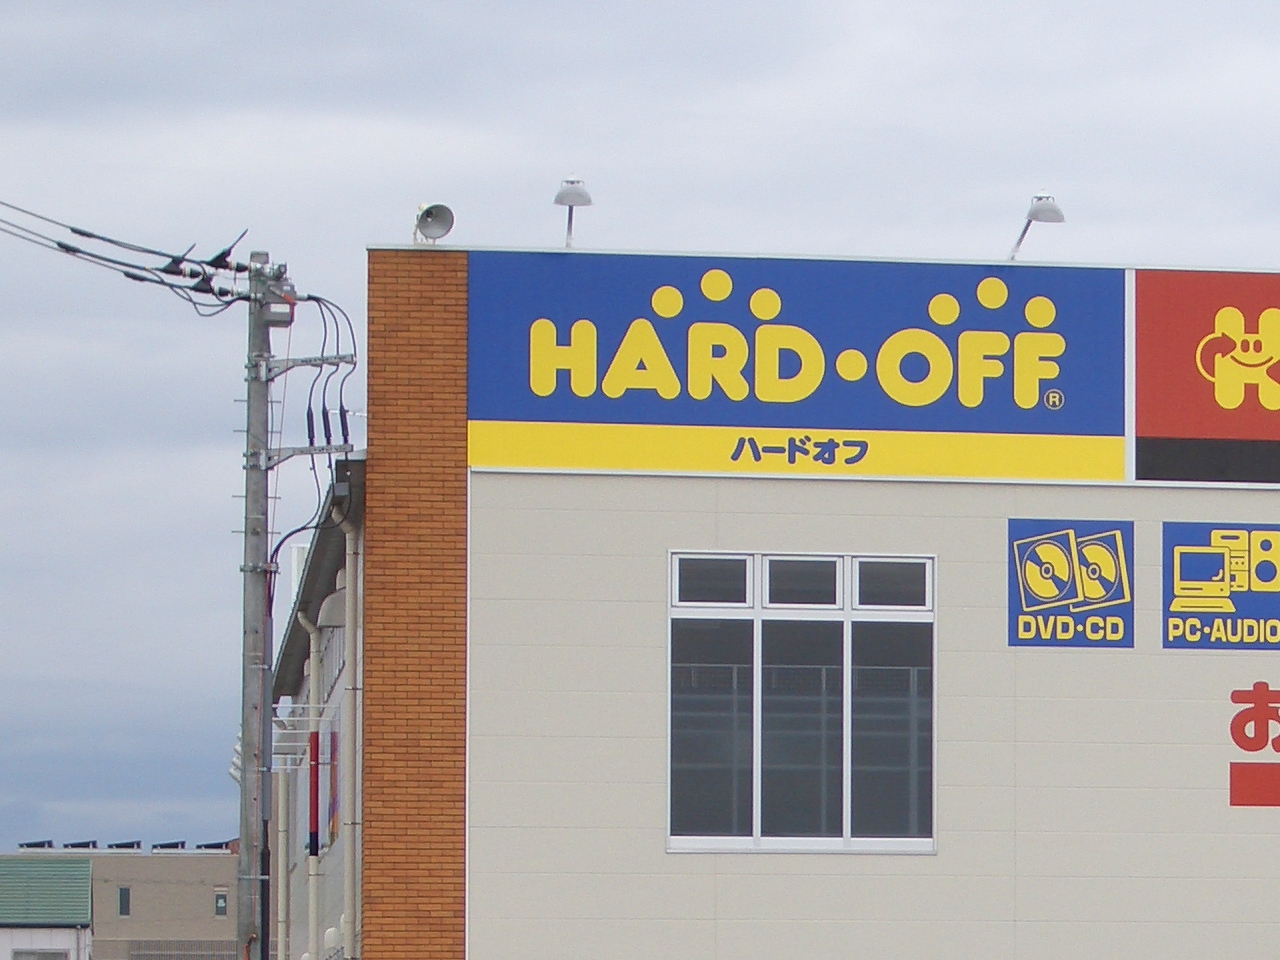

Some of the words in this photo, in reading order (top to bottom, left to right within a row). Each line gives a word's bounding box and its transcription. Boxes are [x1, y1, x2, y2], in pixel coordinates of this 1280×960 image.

[731, 436, 868, 465] ハードオフ
